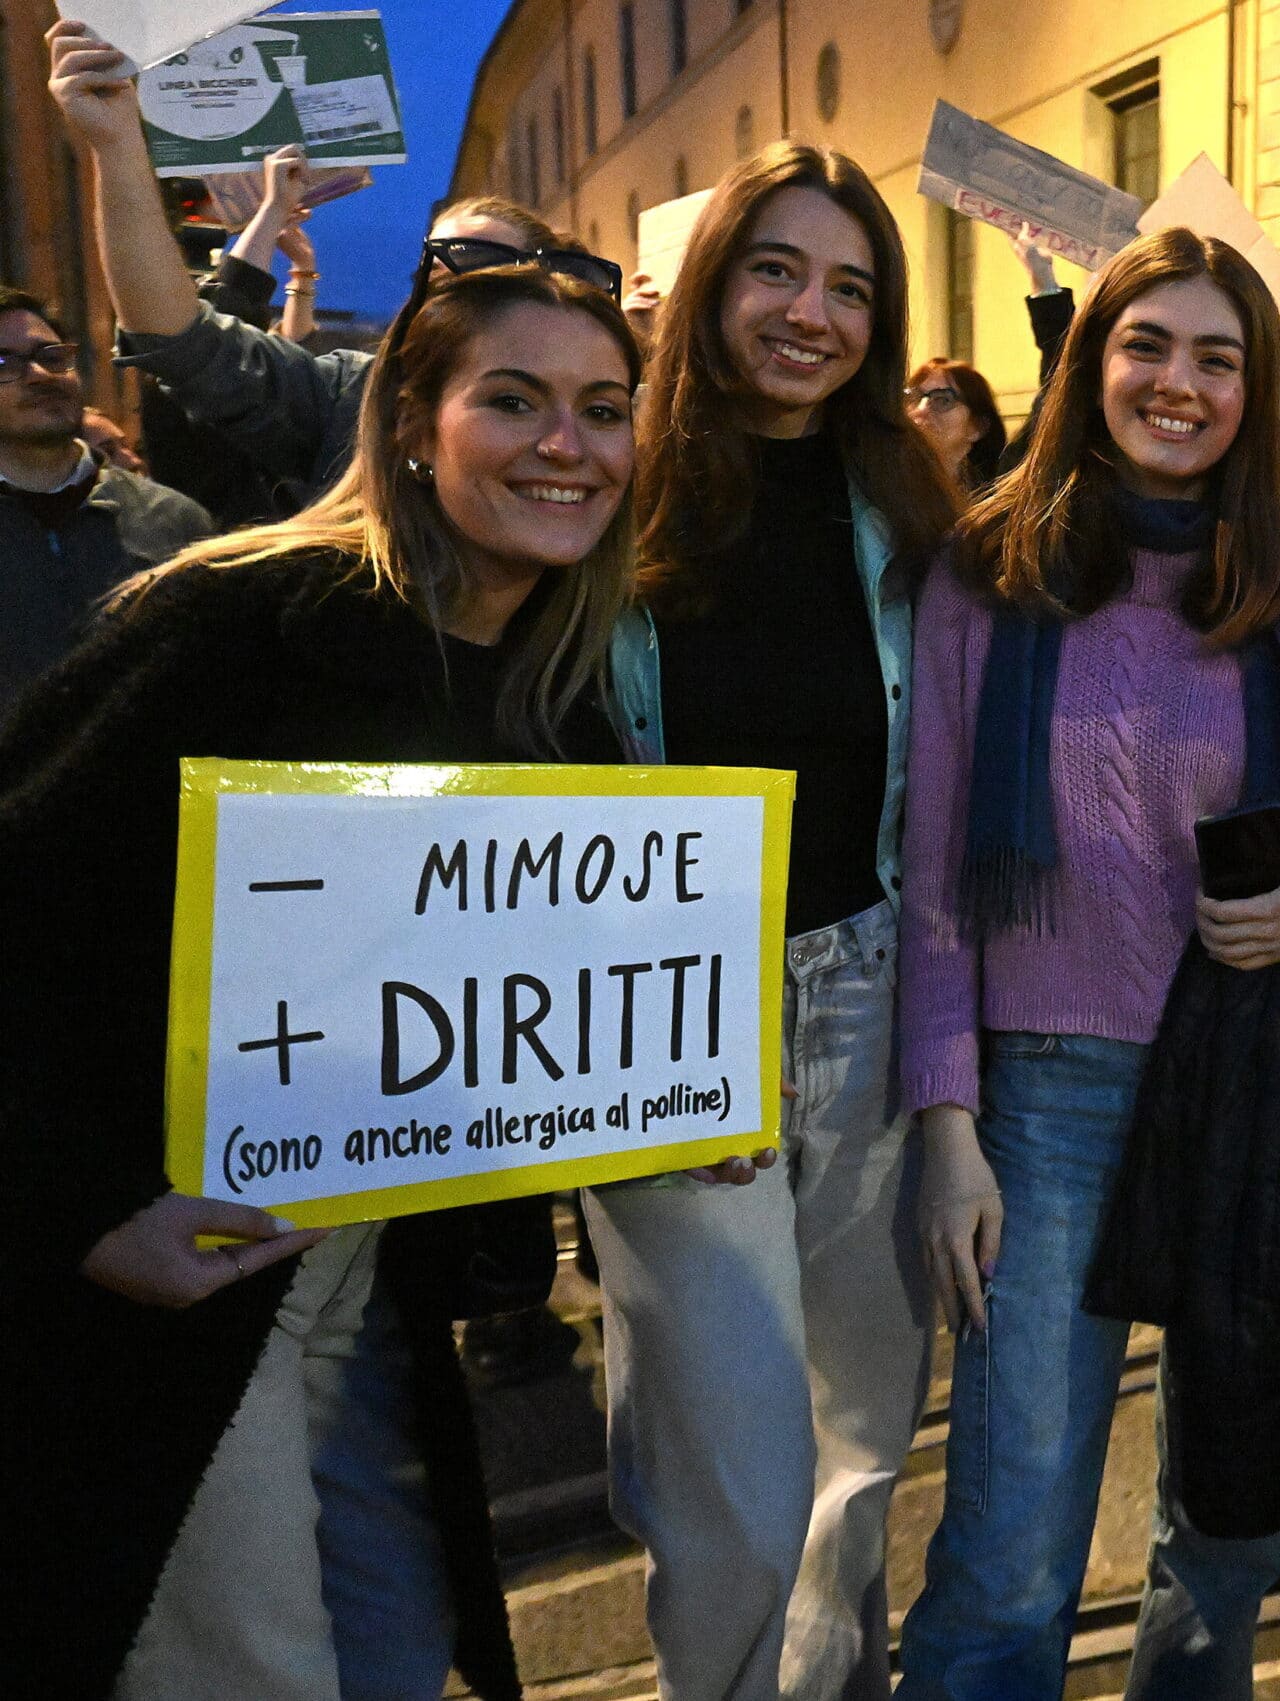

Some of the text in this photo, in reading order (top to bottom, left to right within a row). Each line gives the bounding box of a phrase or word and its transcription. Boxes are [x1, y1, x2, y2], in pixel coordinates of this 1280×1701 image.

[415, 831, 705, 916] MIMOSE
[381, 954, 723, 1097] DIRITTI
[223, 1077, 732, 1195] (sono anche allergica al polline)
